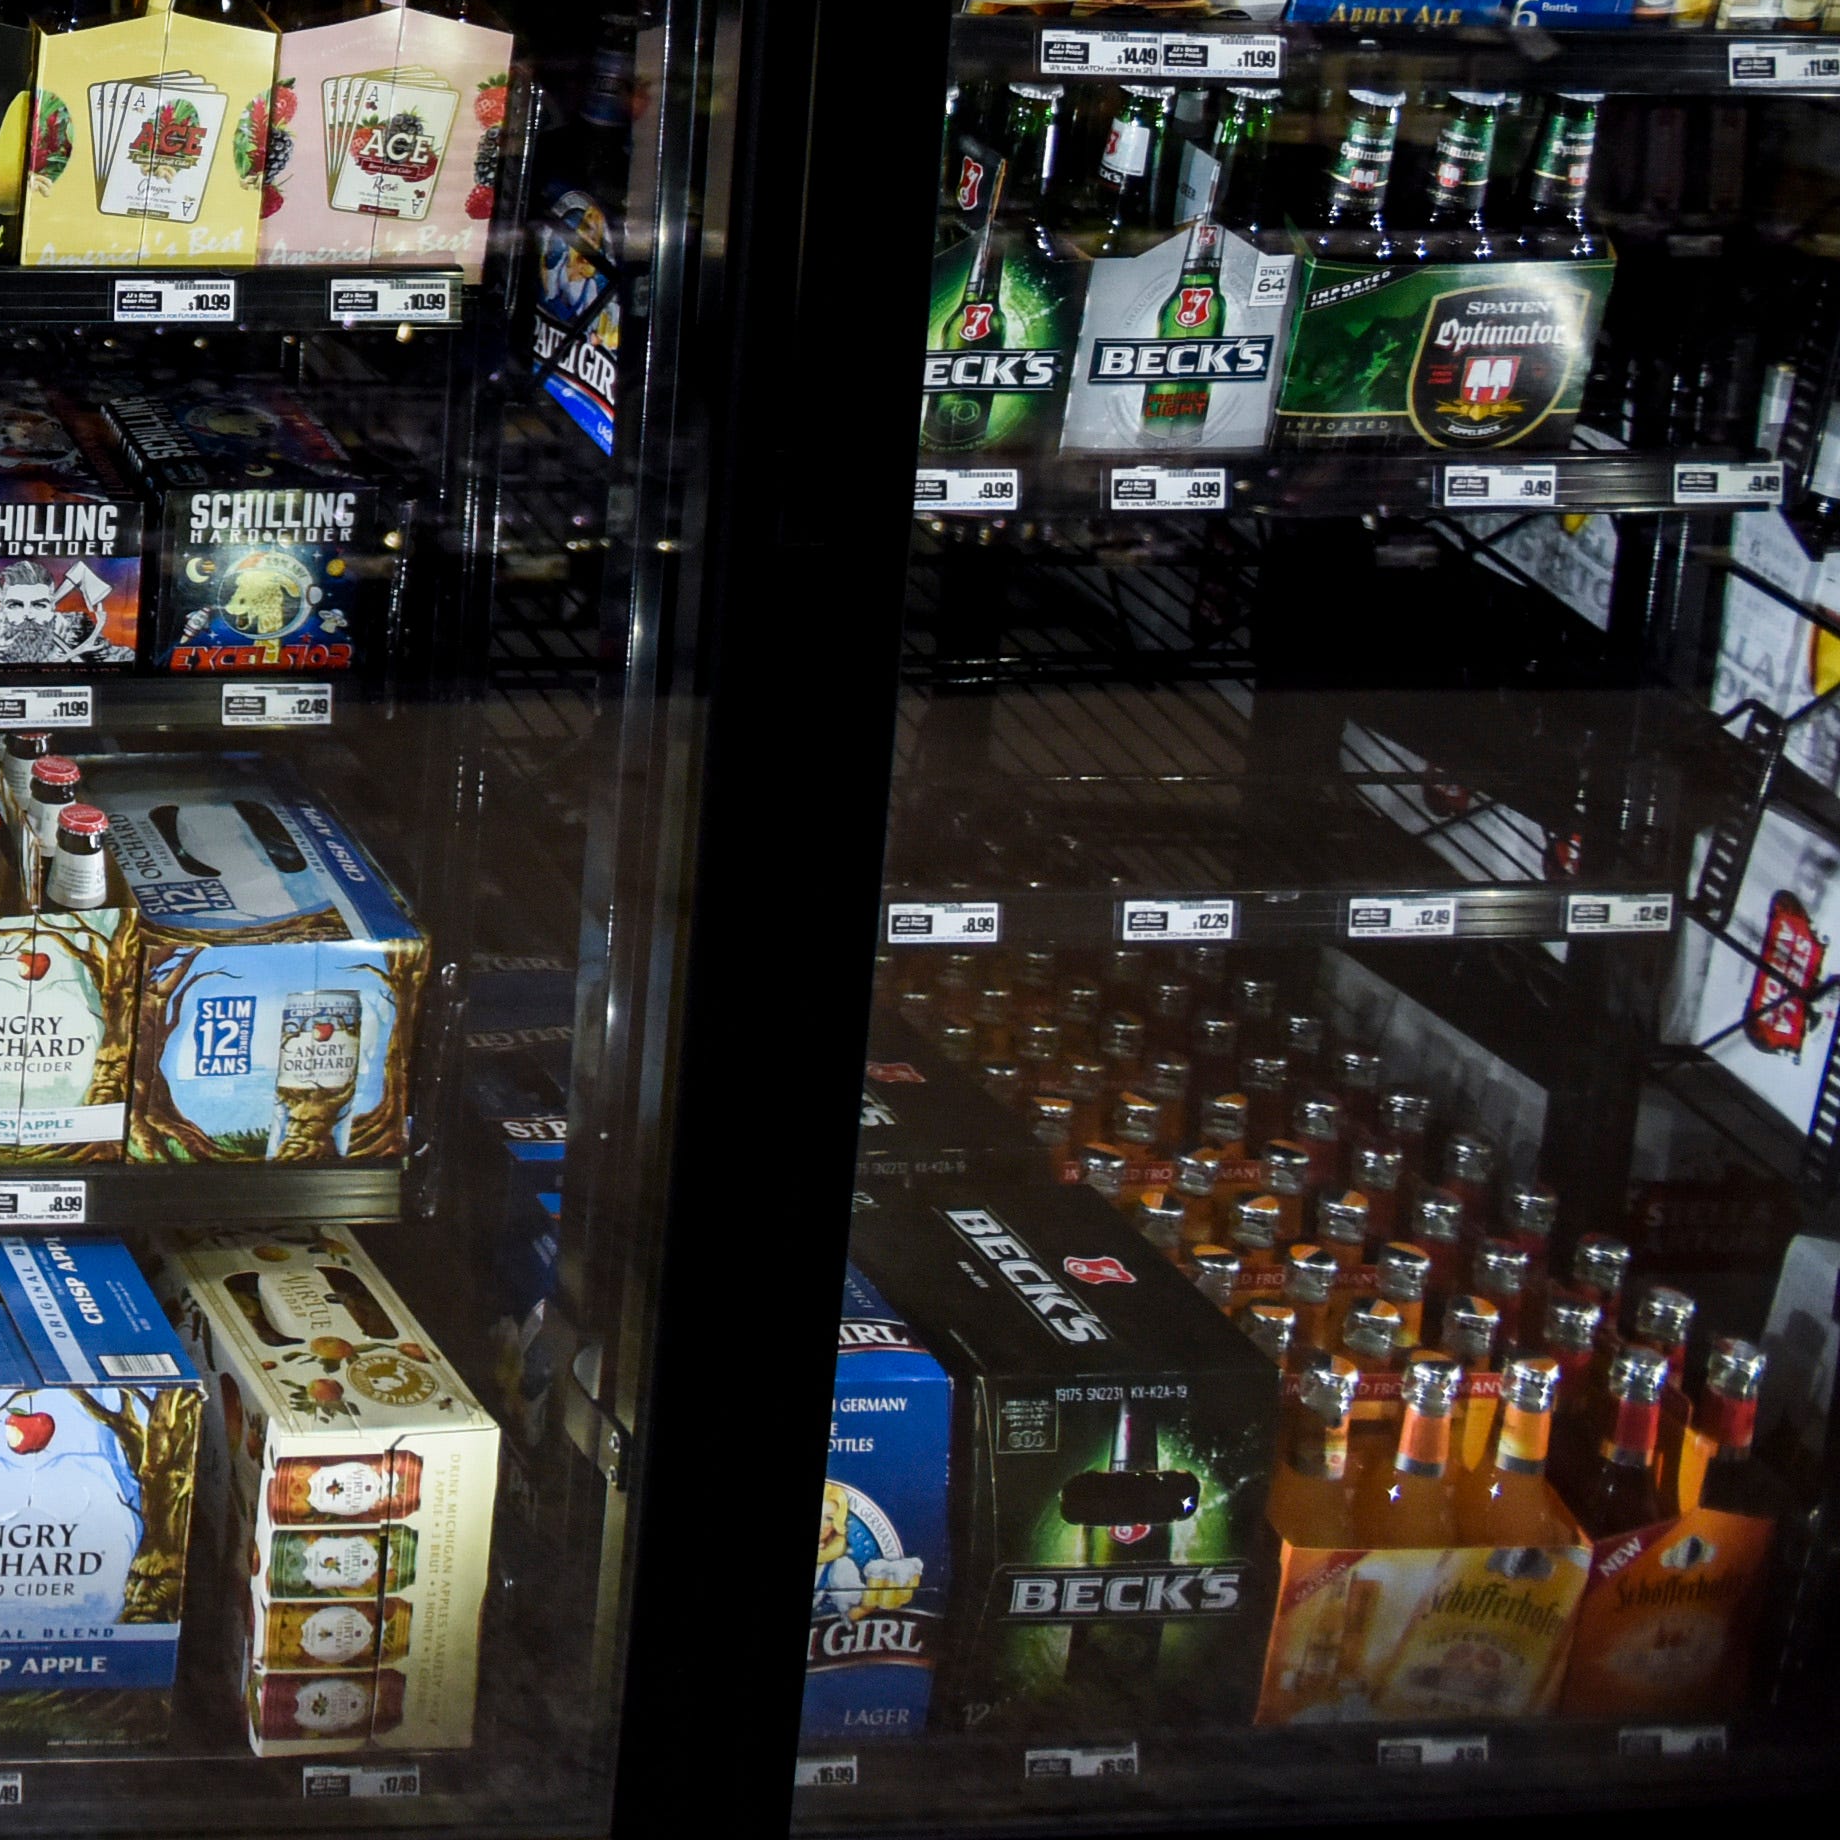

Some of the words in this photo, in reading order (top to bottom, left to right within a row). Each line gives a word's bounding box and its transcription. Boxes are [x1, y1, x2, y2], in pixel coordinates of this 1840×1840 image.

[1117, 46, 1159, 68] $14.49
[1464, 298, 1552, 319] SPATEN
[1435, 315, 1568, 351] Optimator
[1098, 335, 1267, 379] BECK'S
[201, 1000, 252, 1019] SLIM
[198, 1057, 248, 1074] CANS
[22, 1118, 74, 1131] APPLE
[942, 1207, 1109, 1347] BECK'S
[1009, 1561, 1243, 1617] BECK'S
[21, 1656, 108, 1675] APPLE
